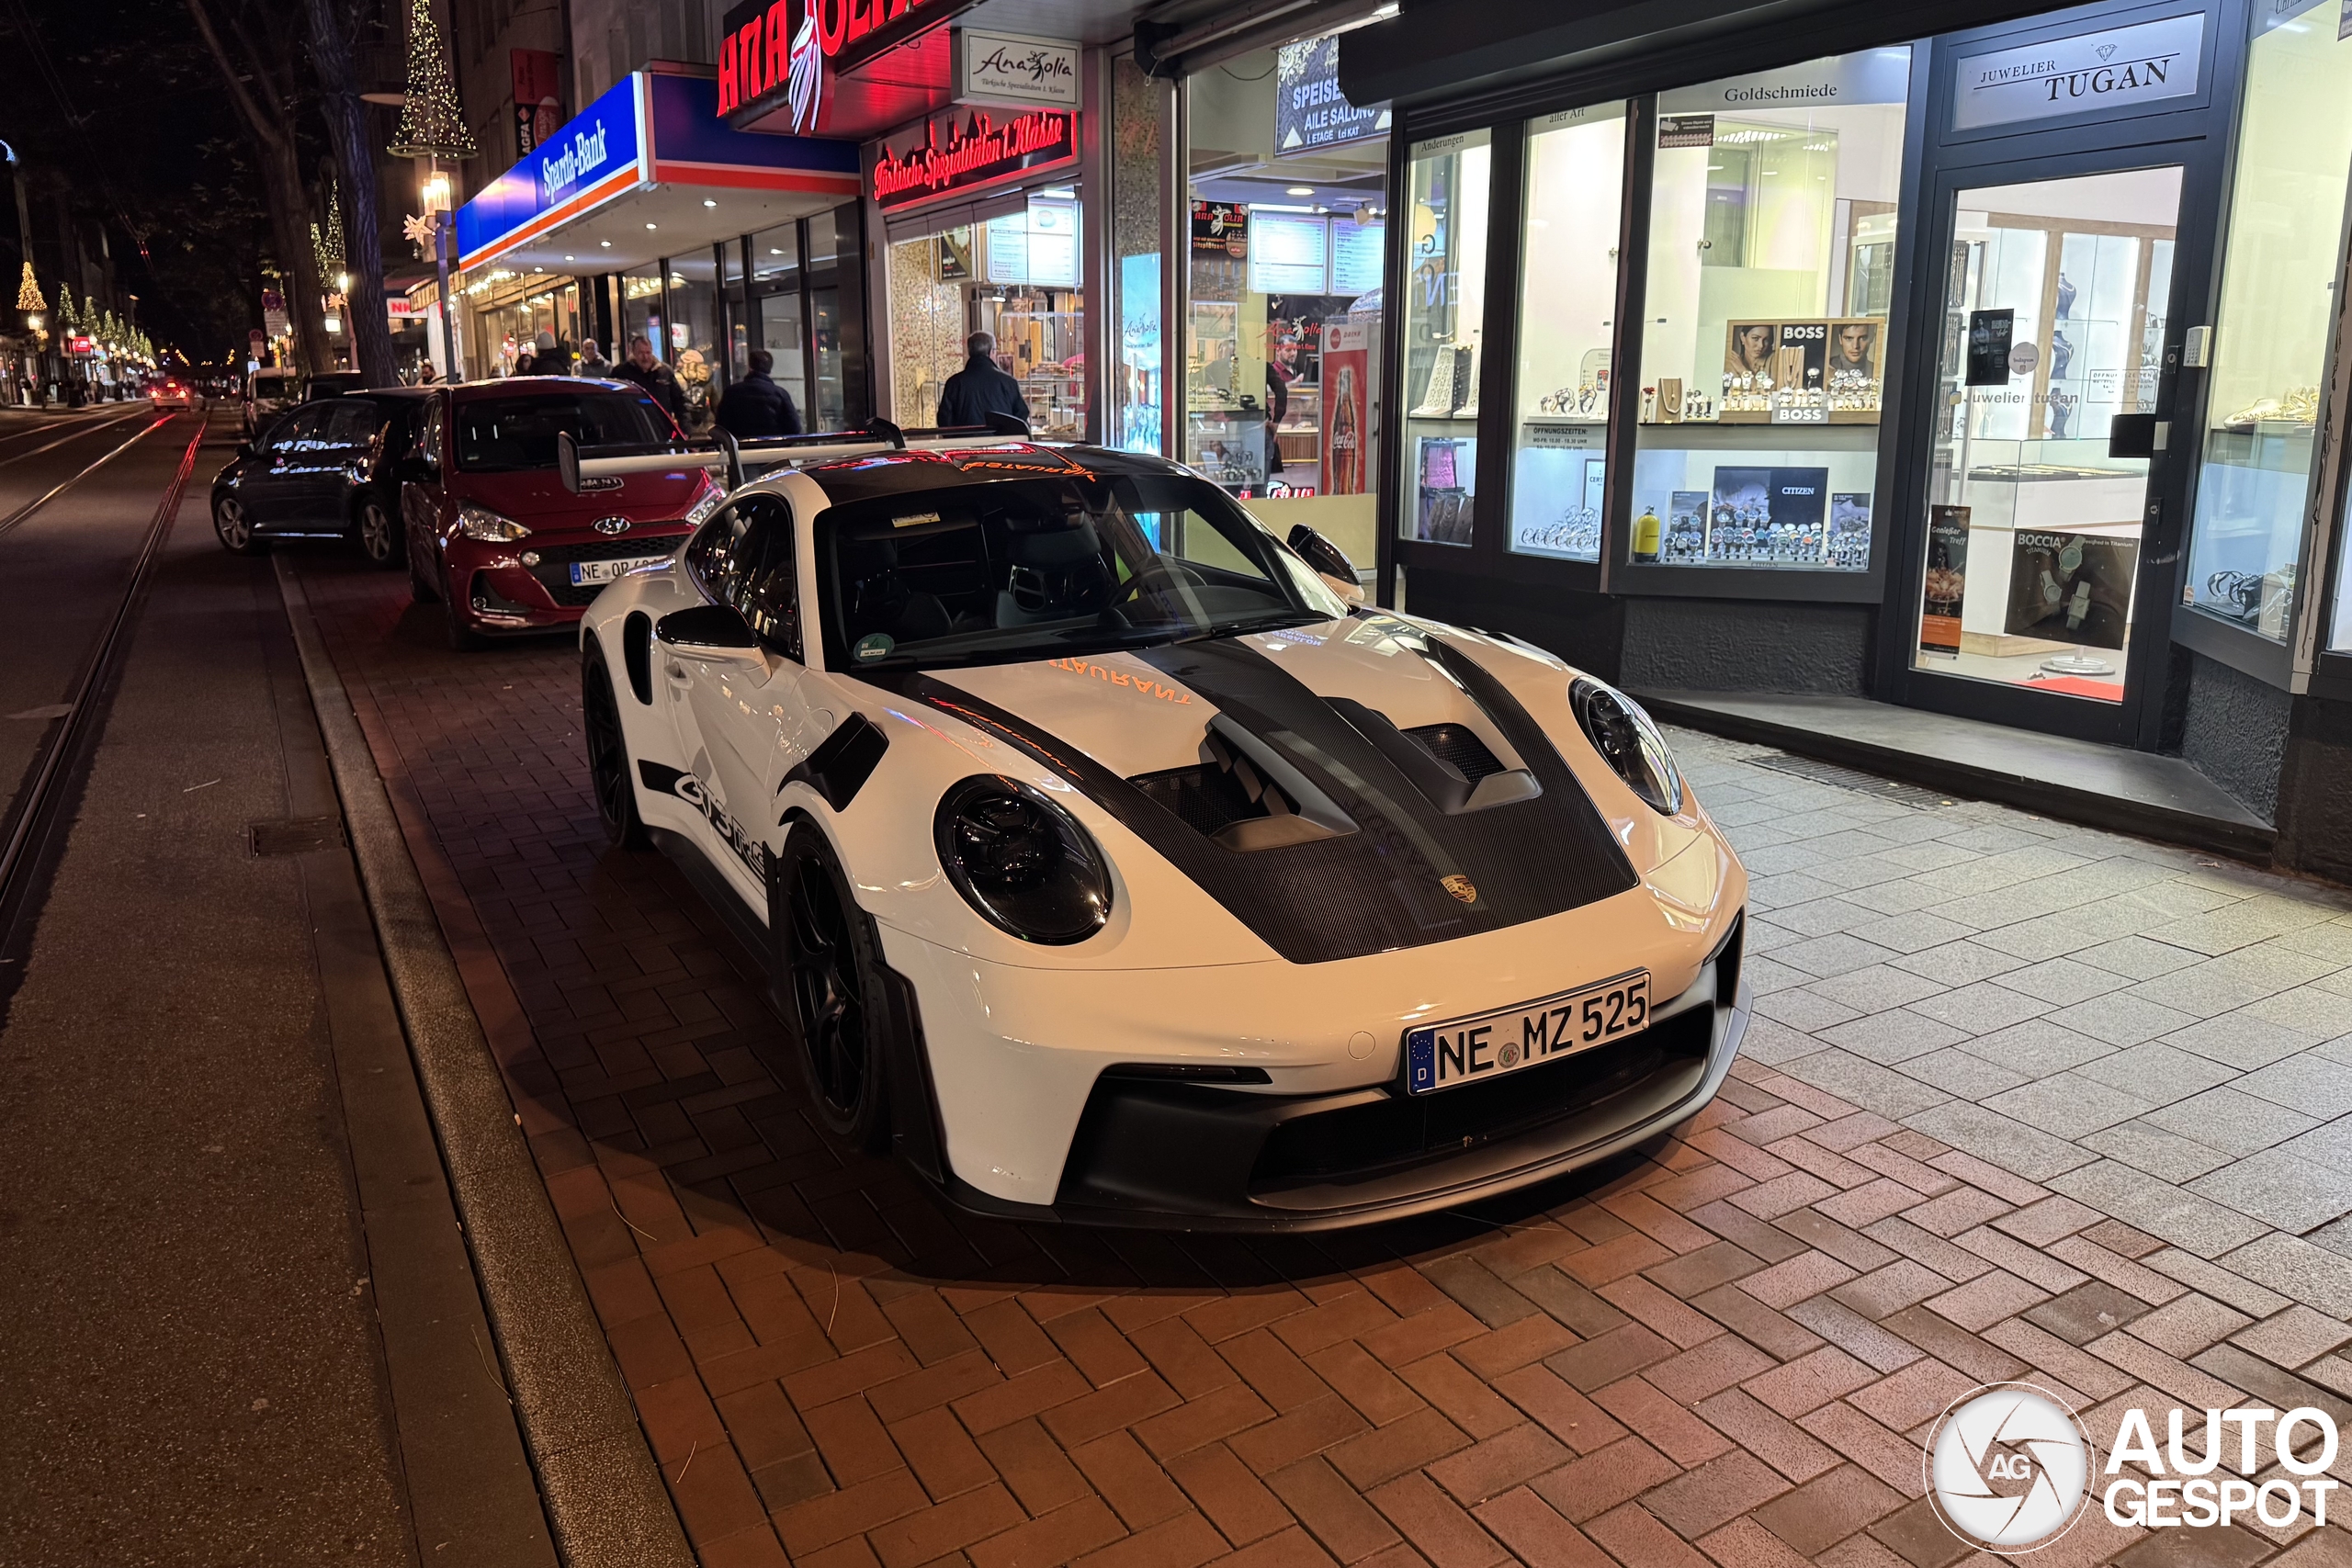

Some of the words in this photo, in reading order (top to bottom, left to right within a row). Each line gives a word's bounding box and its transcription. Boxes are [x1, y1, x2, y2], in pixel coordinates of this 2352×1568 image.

[1980, 60, 2057, 83] JUWELIER
[2044, 59, 2171, 101] TUGAN
[1292, 77, 1346, 110] SPEISE
[1724, 84, 1838, 102] Goldschmiede
[1304, 109, 1329, 131] AILE
[1569, 107, 1585, 119] Art
[520, 122, 531, 154] AGFA
[1312, 129, 1334, 143] ETAGE
[1347, 125, 1360, 138] KAT
[542, 118, 607, 205] Sparda-Bank
[874, 153, 924, 201] Türkische
[923, 134, 1001, 190] Spezialitäten
[1012, 114, 1063, 157] Klasse
[1783, 326, 1825, 339] BOSS
[1963, 391, 2025, 403] uwelier
[1779, 409, 1822, 421] BOSS
[1533, 426, 1589, 435] ÖFFNUNGSZEITEN:
[1781, 487, 1815, 495] CITIZEN
[1949, 536, 1967, 546] Treff
[2018, 534, 2061, 548] BOCCIA
[2026, 546, 2052, 558] TITANIUM
[581, 563, 601, 581] NE
[1418, 1067, 1427, 1081] D
[1439, 1025, 1494, 1080] NE
[1523, 1005, 1573, 1060] MZ
[1583, 982, 1646, 1042] 525
